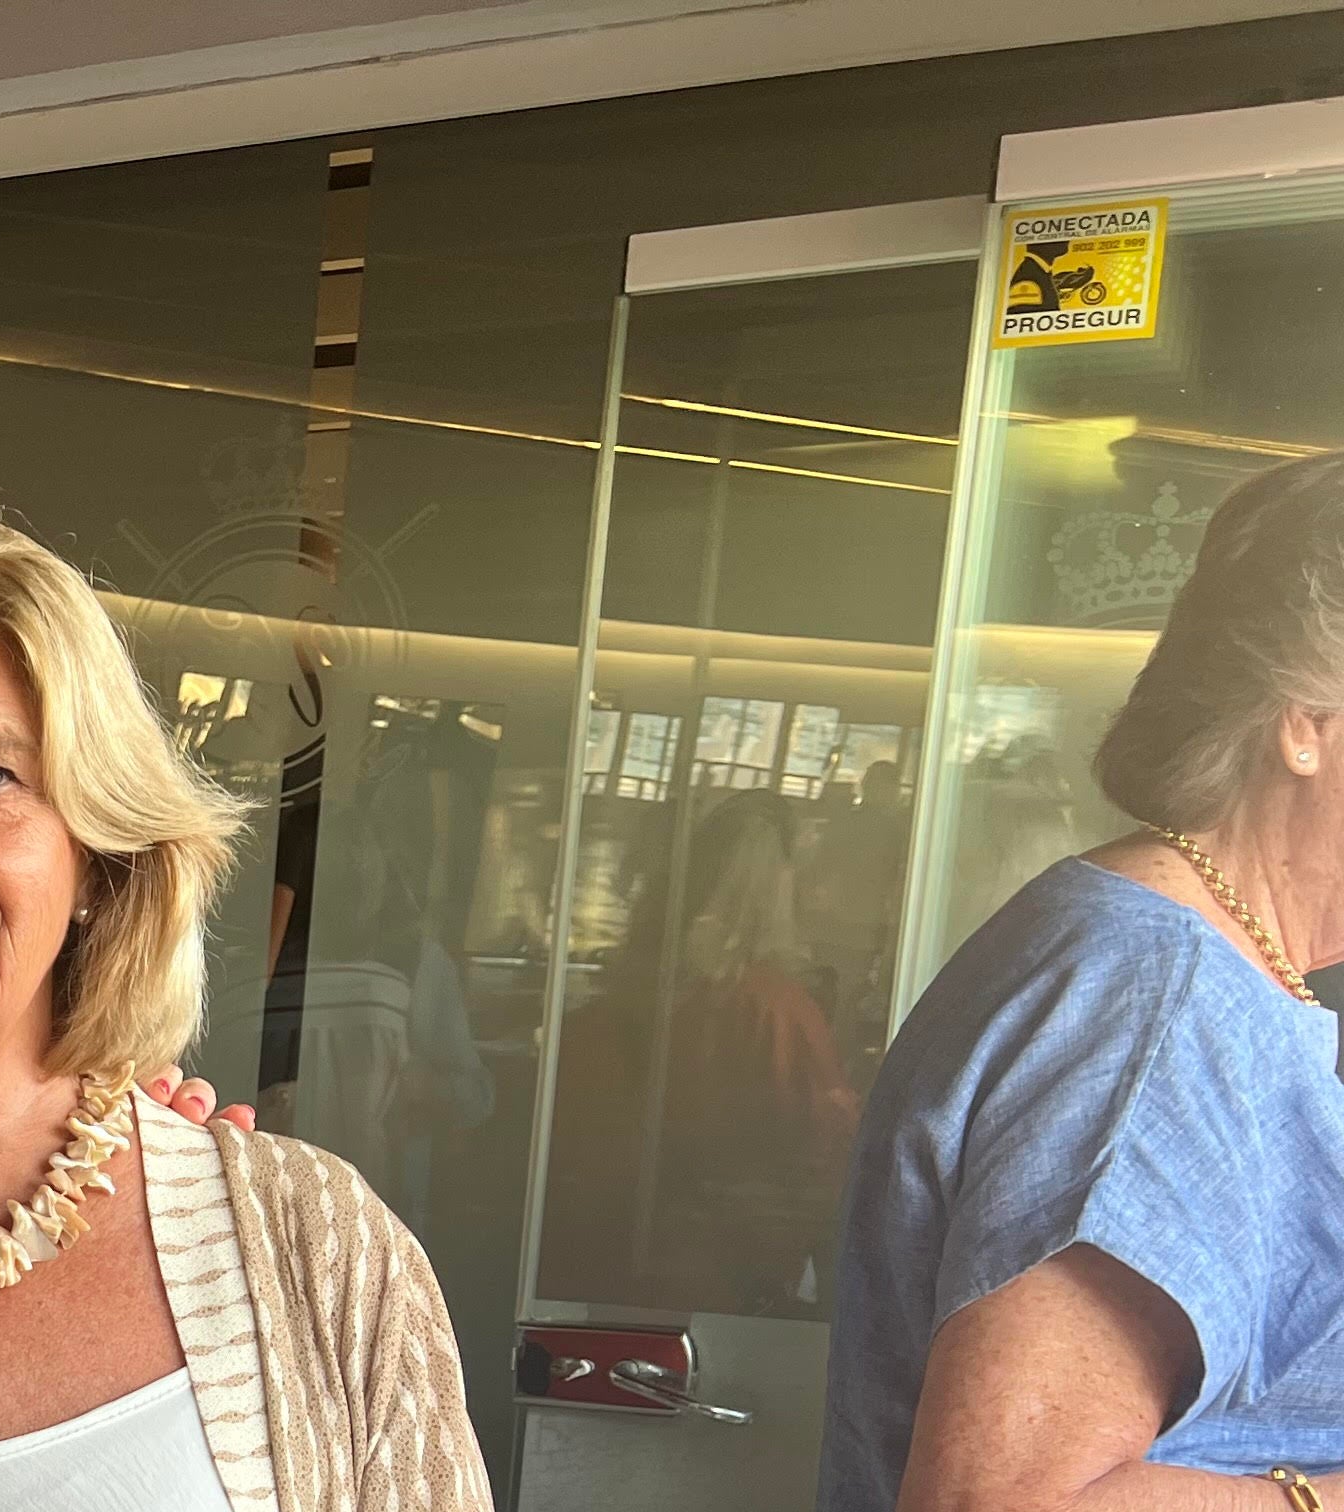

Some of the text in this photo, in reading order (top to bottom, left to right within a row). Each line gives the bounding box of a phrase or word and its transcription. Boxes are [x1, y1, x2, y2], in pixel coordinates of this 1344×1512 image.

[1015, 210, 1150, 236] CONECTADA
[1072, 241, 1095, 252] 902
[1124, 237, 1146, 248] 999
[1003, 308, 1141, 335] PROSEGUR
